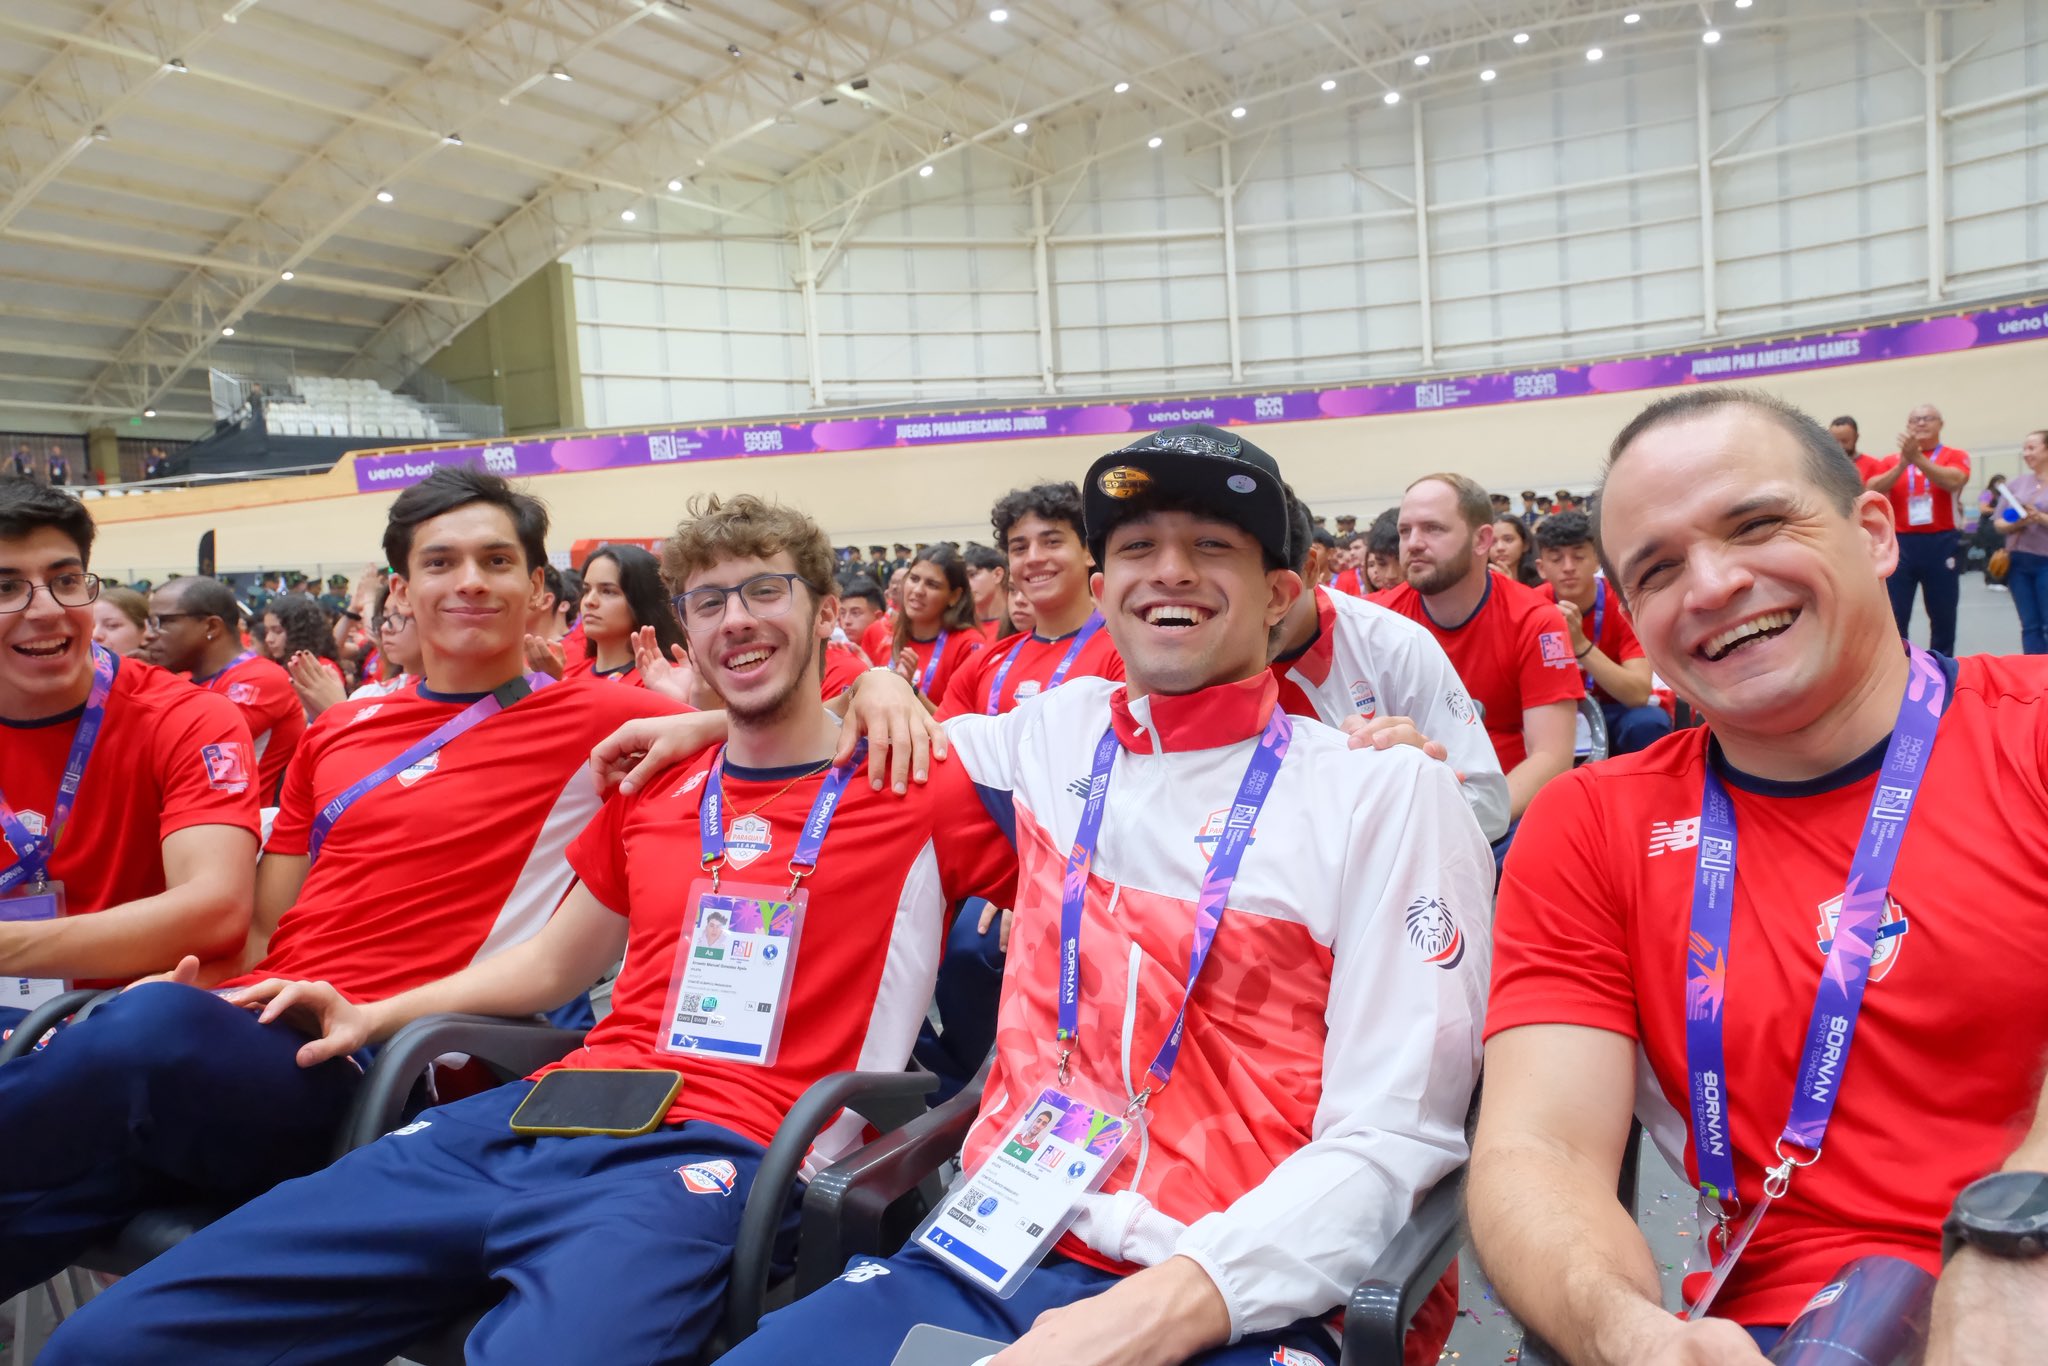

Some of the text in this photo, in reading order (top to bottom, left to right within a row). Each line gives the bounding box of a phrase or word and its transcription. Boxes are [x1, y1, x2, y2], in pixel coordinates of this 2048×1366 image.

[1997, 316, 2042, 334] ueno
[1691, 338, 1860, 375] JUNIOR PAN AMERICAN GAMES
[1514, 373, 1557, 388] PANAM
[1514, 384, 1557, 398] SPORTS
[896, 415, 1048, 438] JUEGOS PANAMERICANOS JUNIOR
[1148, 407, 1215, 422] ueno bank
[743, 430, 782, 443] PANAM
[744, 440, 783, 452] SPORTS
[368, 468, 404, 481] ueno
[1891, 734, 1911, 771] SPORTS
[1903, 738, 1924, 773] PANAM
[1244, 769, 1260, 794] SPORTS
[1253, 771, 1269, 795] PANAM
[708, 794, 719, 837] BORNAN
[811, 792, 836, 839] BORNAN
[732, 834, 763, 842] PARAGUAY
[1066, 937, 1076, 1004] BORNAN
[1802, 1014, 1830, 1098] SPORTS TECHNOLOGY
[1811, 1015, 1848, 1103] BORNAN
[1695, 1071, 1710, 1153] SPORTS TECHNOLOGY
[1703, 1070, 1725, 1156] BORNAN
[933, 1232, 953, 1249] A 2
